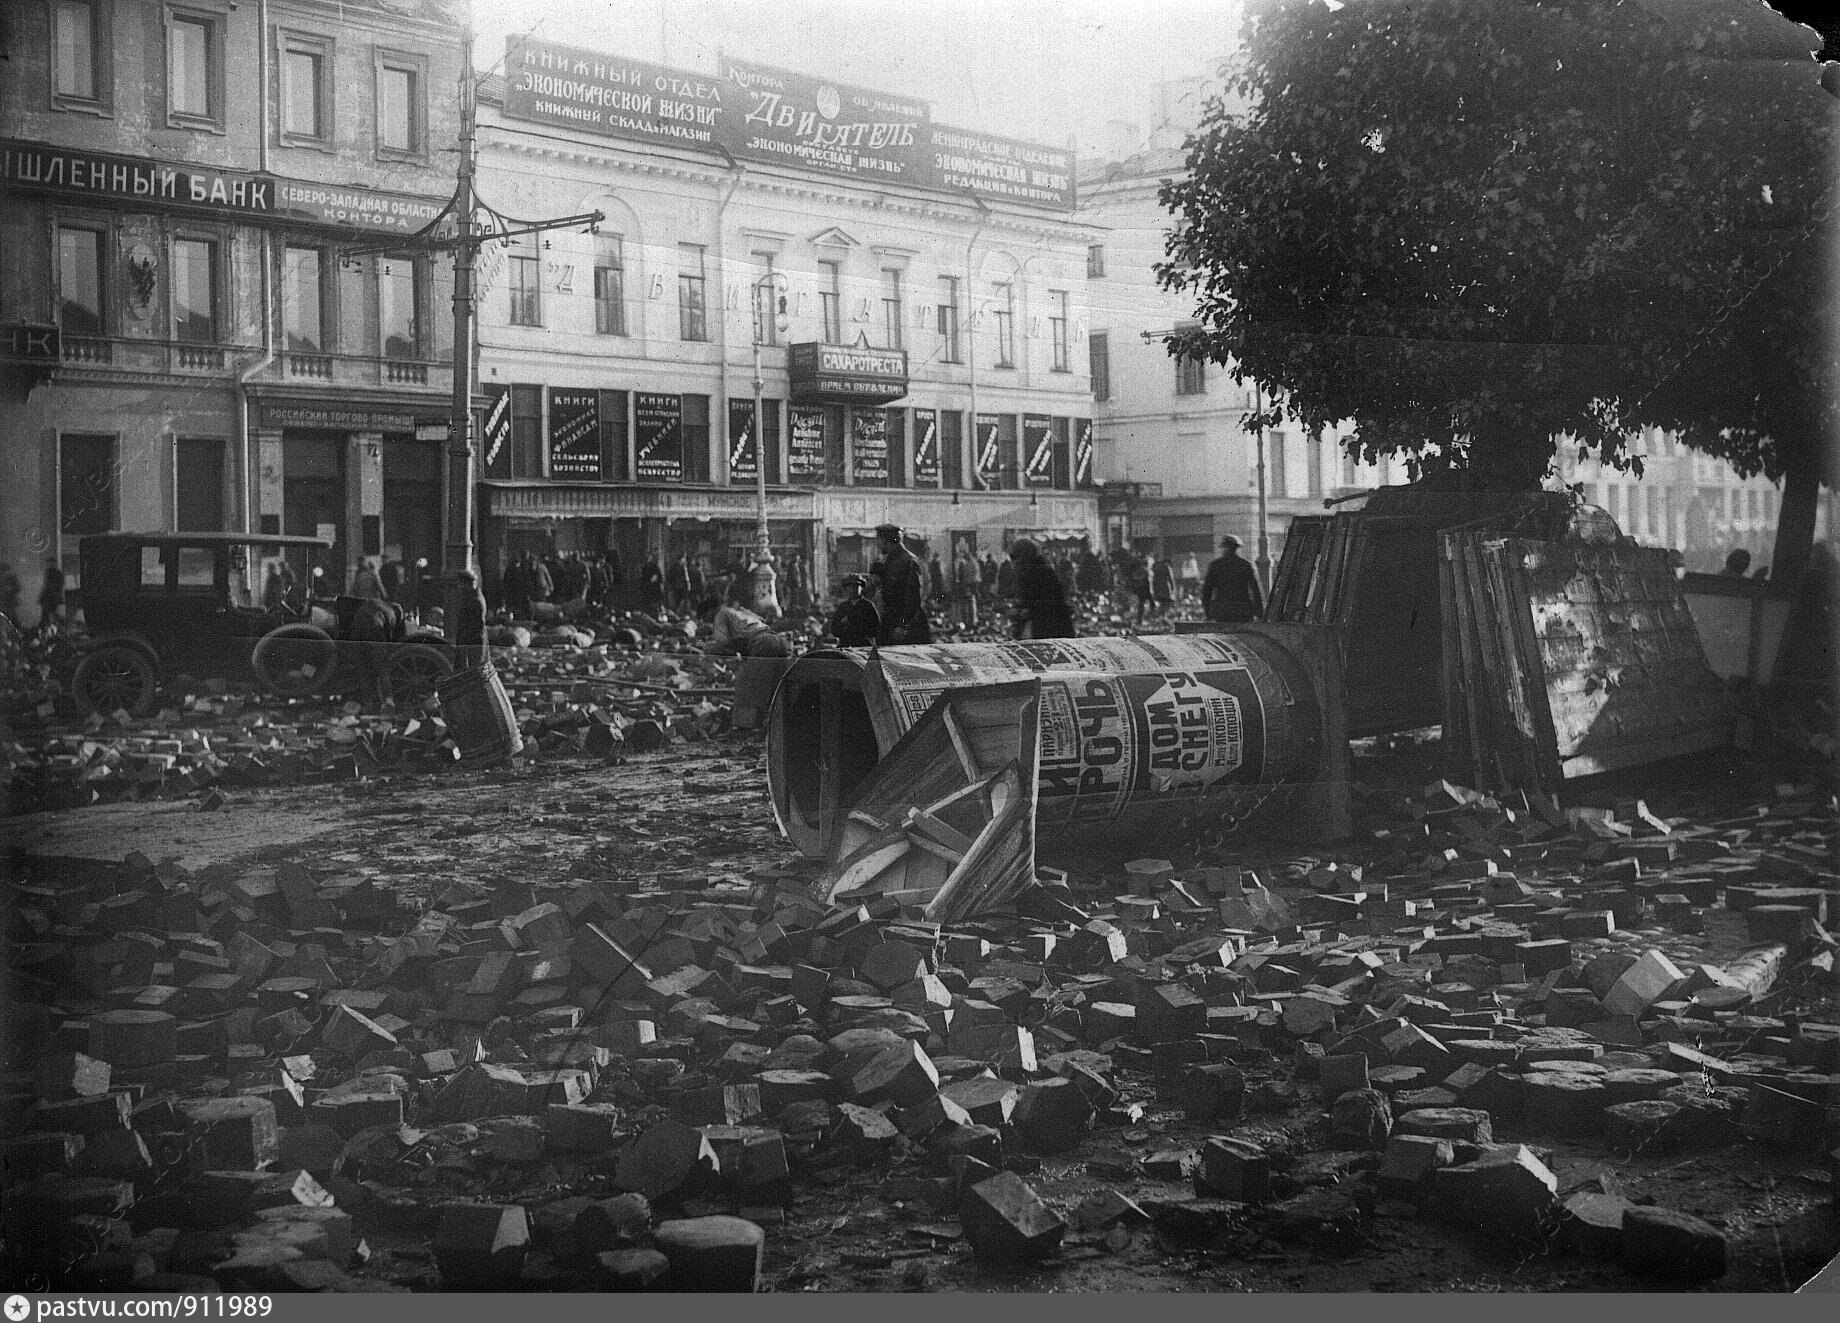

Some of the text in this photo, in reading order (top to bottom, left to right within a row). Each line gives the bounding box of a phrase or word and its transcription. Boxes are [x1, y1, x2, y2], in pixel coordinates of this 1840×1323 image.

[525, 50, 721, 102] КНИЖНЫЙ ОТДЕЛ
[535, 100, 601, 122] КНИЖНЫЙ
[609, 114, 653, 134] СКЛАД
[659, 124, 711, 142] МАГАЗИН
[189, 173, 267, 210] БАНК
[281, 187, 388, 213] СЕВЕРО-ЗАПАДНАЯ
[323, 208, 409, 228] КОНТОРА
[823, 353, 904, 376] САХАРОТРЕСТА
[554, 395, 595, 406] КНИГИ
[639, 396, 679, 407] КНИГИ
[1145, 701, 1182, 770] ДОМ
[1163, 671, 1209, 773] СНЕГУ
[1210, 697, 1227, 746] ЯКОБИНИ
[1222, 697, 1239, 743] КАПОЦЦИ
